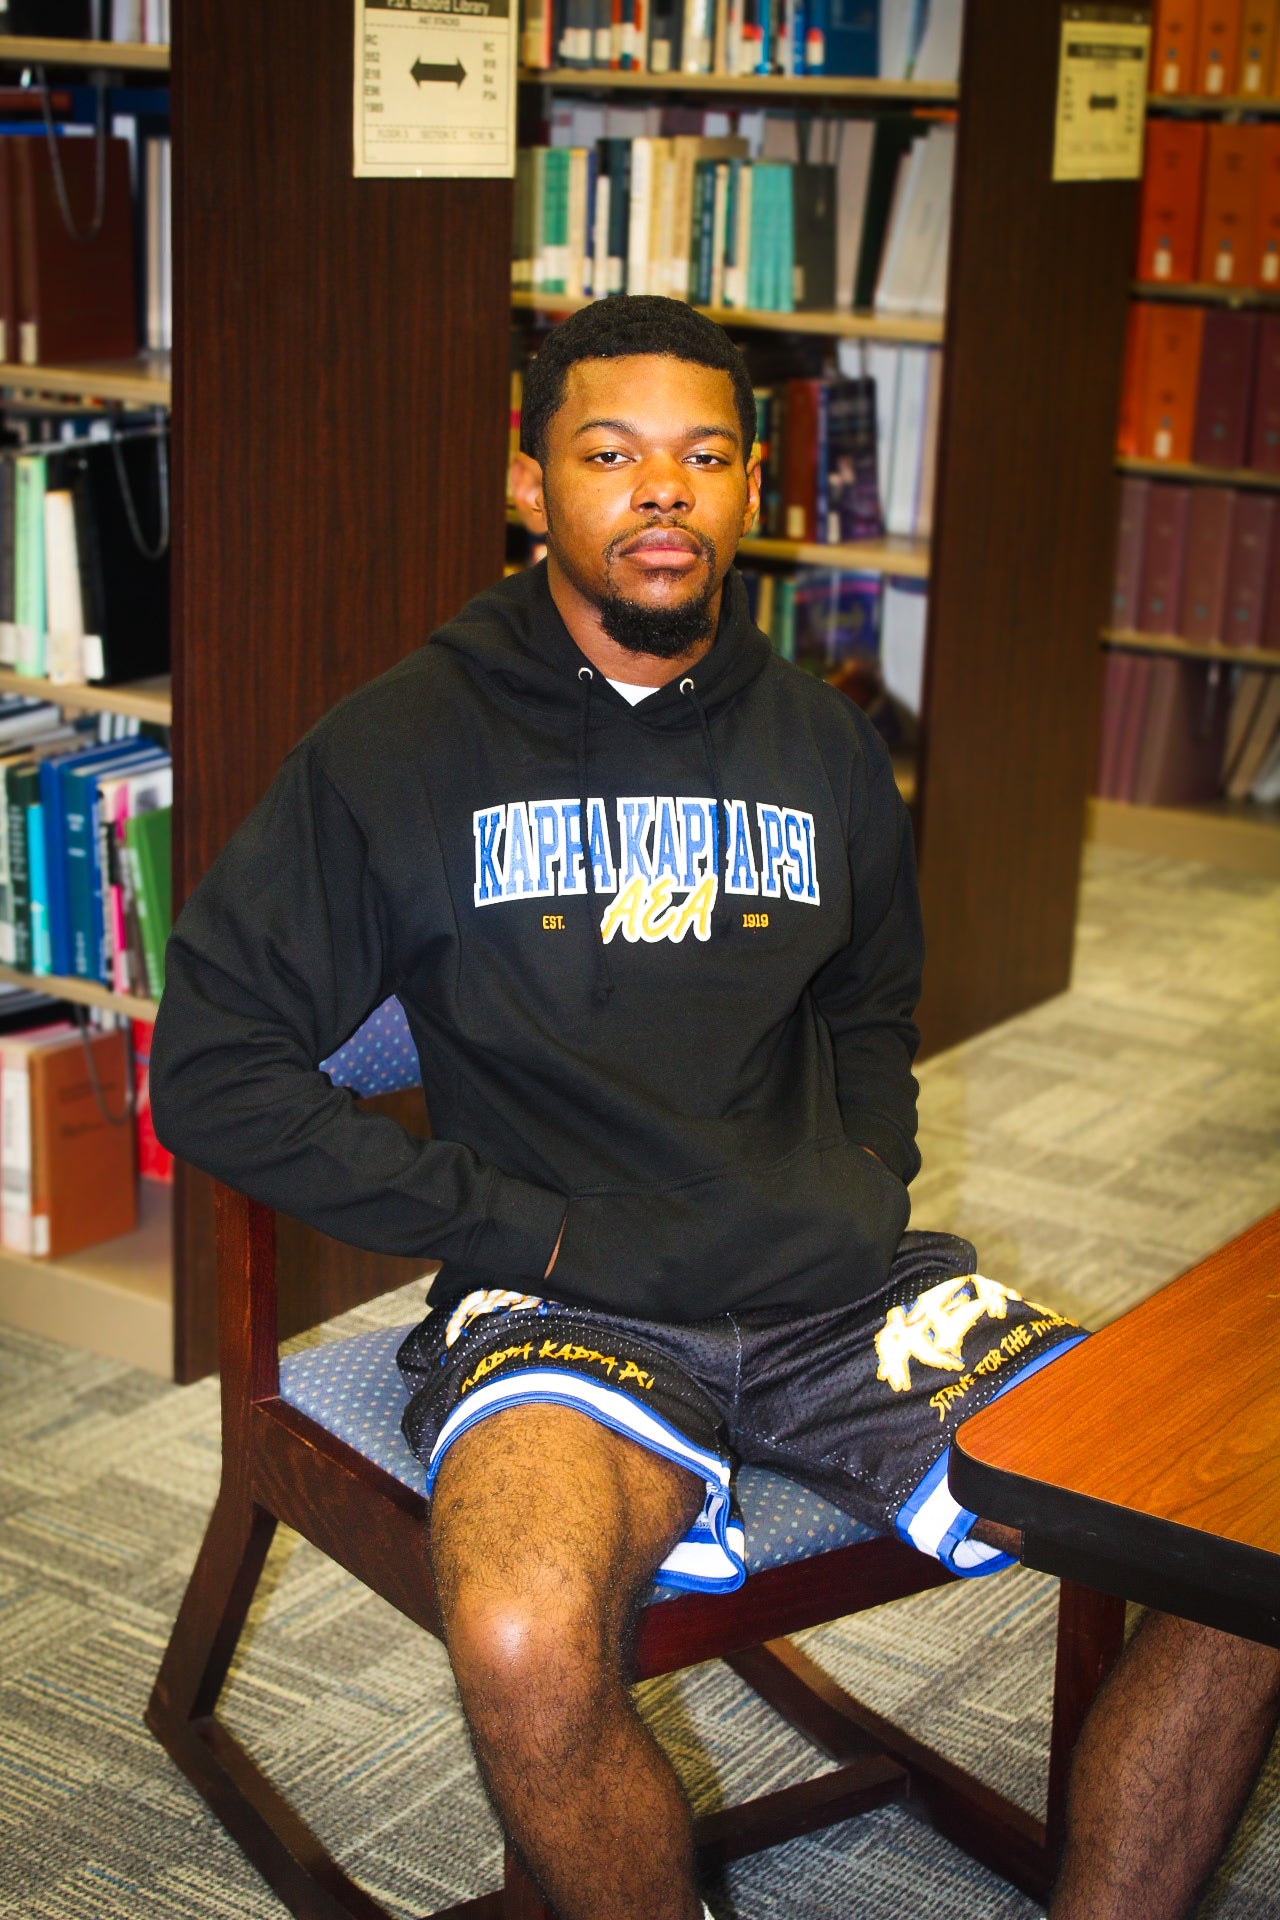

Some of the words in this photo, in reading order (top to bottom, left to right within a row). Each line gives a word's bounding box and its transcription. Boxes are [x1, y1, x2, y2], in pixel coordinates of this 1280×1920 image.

[473, 797, 618, 907] KAPPA
[757, 802, 820, 906] PSI
[542, 915, 565, 930] EST.
[742, 913, 769, 928] 1919
[974, 1348, 1008, 1376] FOR
[1000, 1325, 1033, 1357] THE
